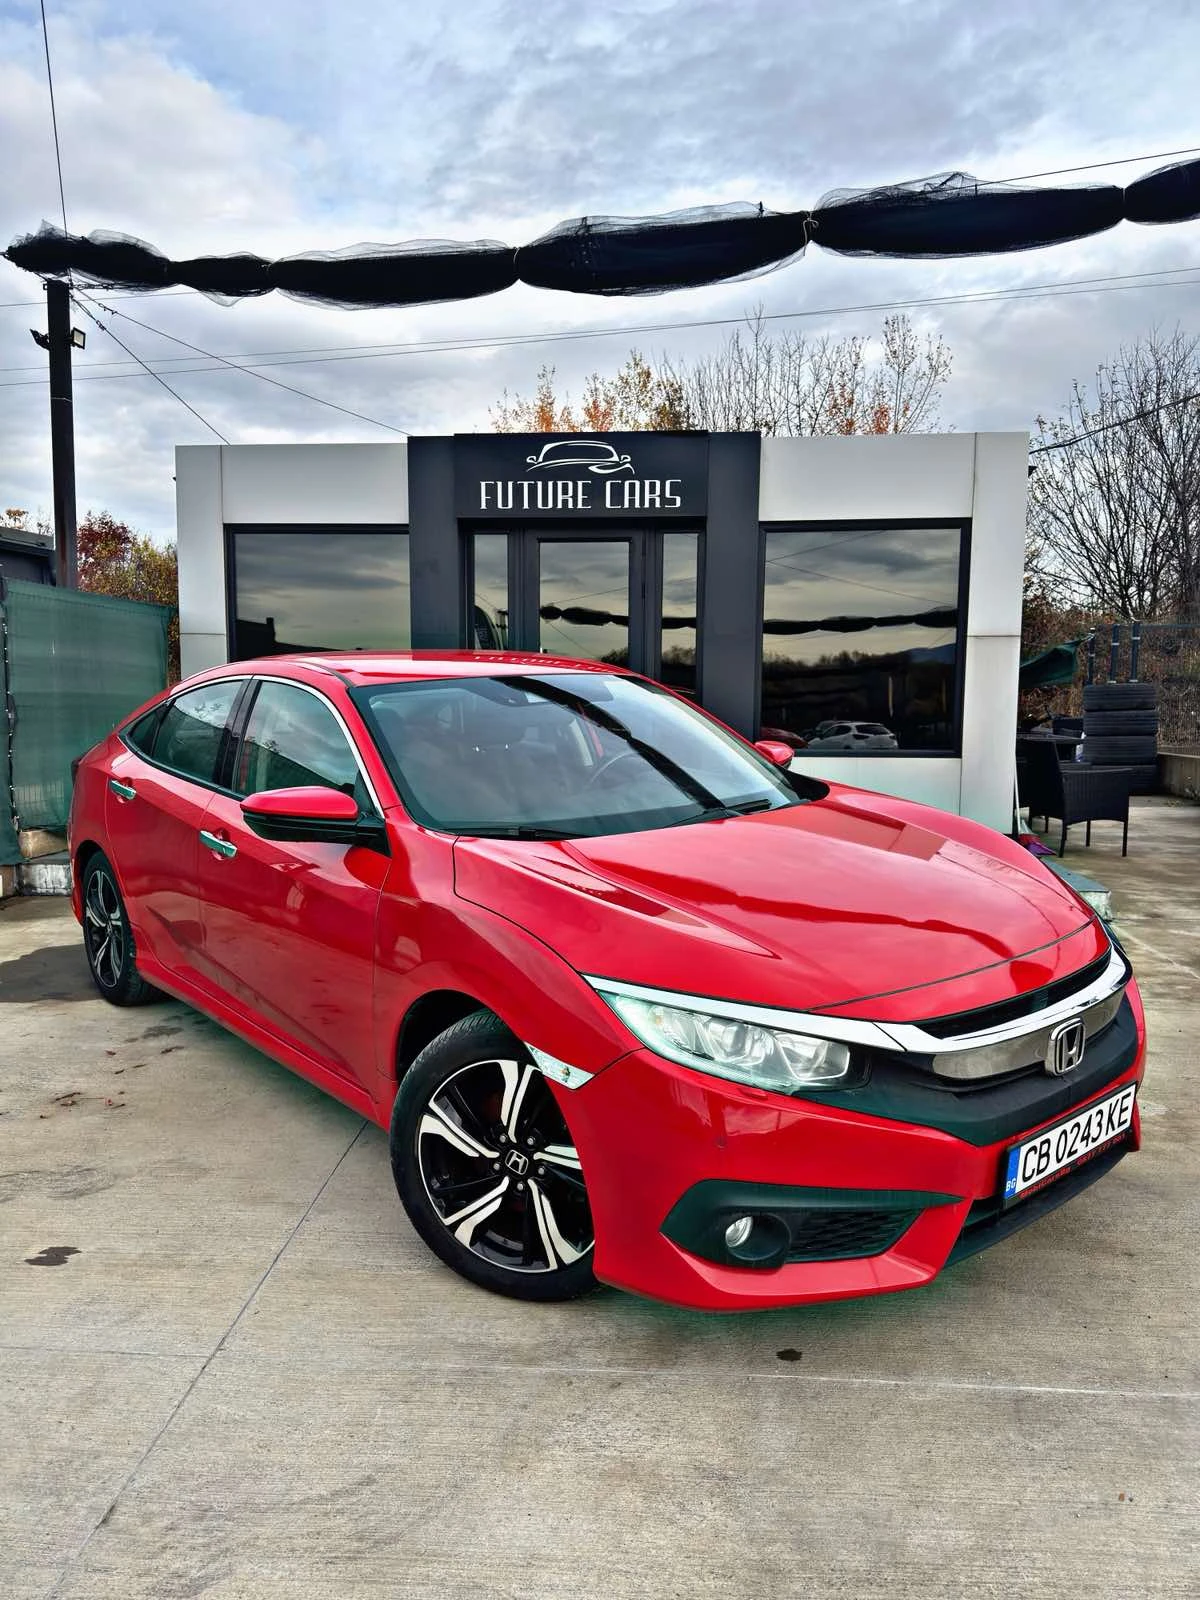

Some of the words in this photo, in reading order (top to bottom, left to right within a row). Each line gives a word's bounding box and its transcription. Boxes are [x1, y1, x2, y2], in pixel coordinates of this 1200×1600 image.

[479, 480, 592, 510] FUTURE
[605, 479, 682, 509] CARS
[1021, 1137, 1052, 1183] CB
[1055, 1108, 1104, 1164] 0243
[1105, 1091, 1132, 1136] KE
[1005, 1177, 1017, 1192] BG
